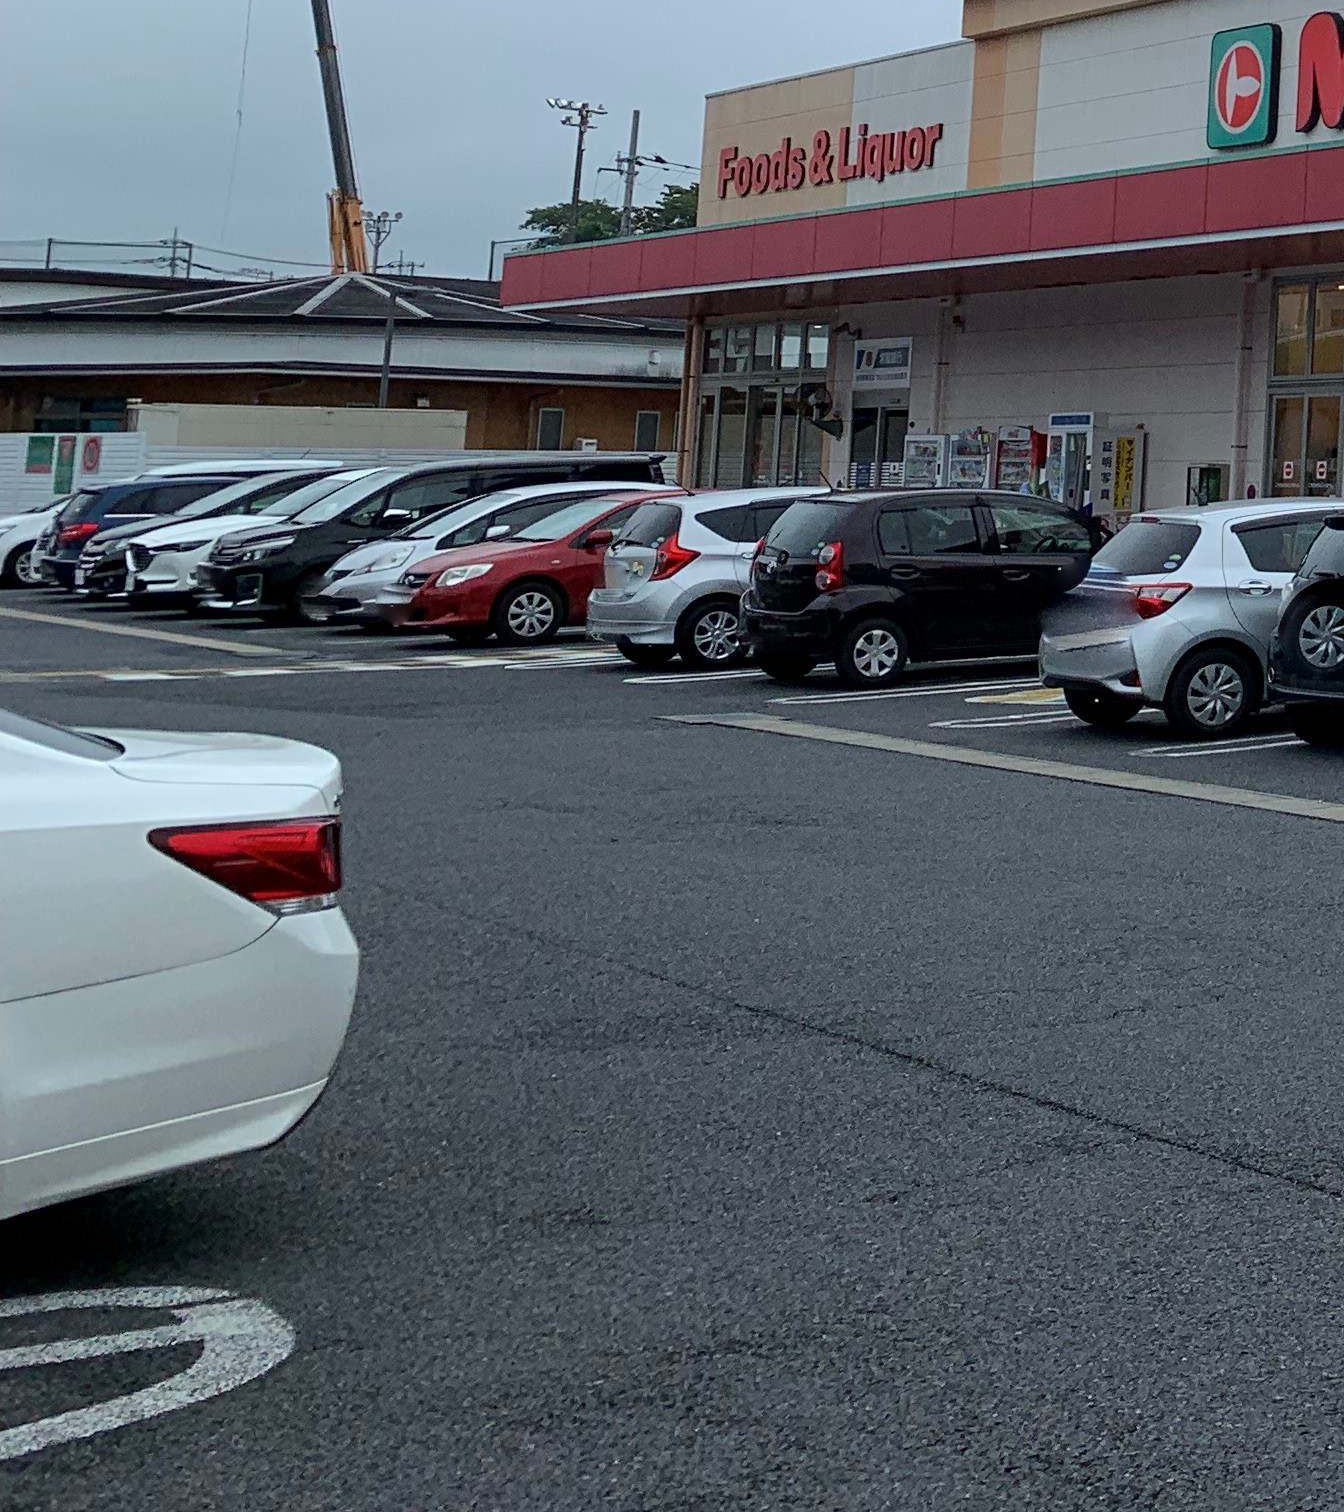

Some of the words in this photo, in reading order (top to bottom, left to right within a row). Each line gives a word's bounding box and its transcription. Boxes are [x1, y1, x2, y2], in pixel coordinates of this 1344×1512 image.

[717, 137, 806, 199] Foods
[809, 129, 834, 186] &
[837, 123, 944, 183] Liquor
